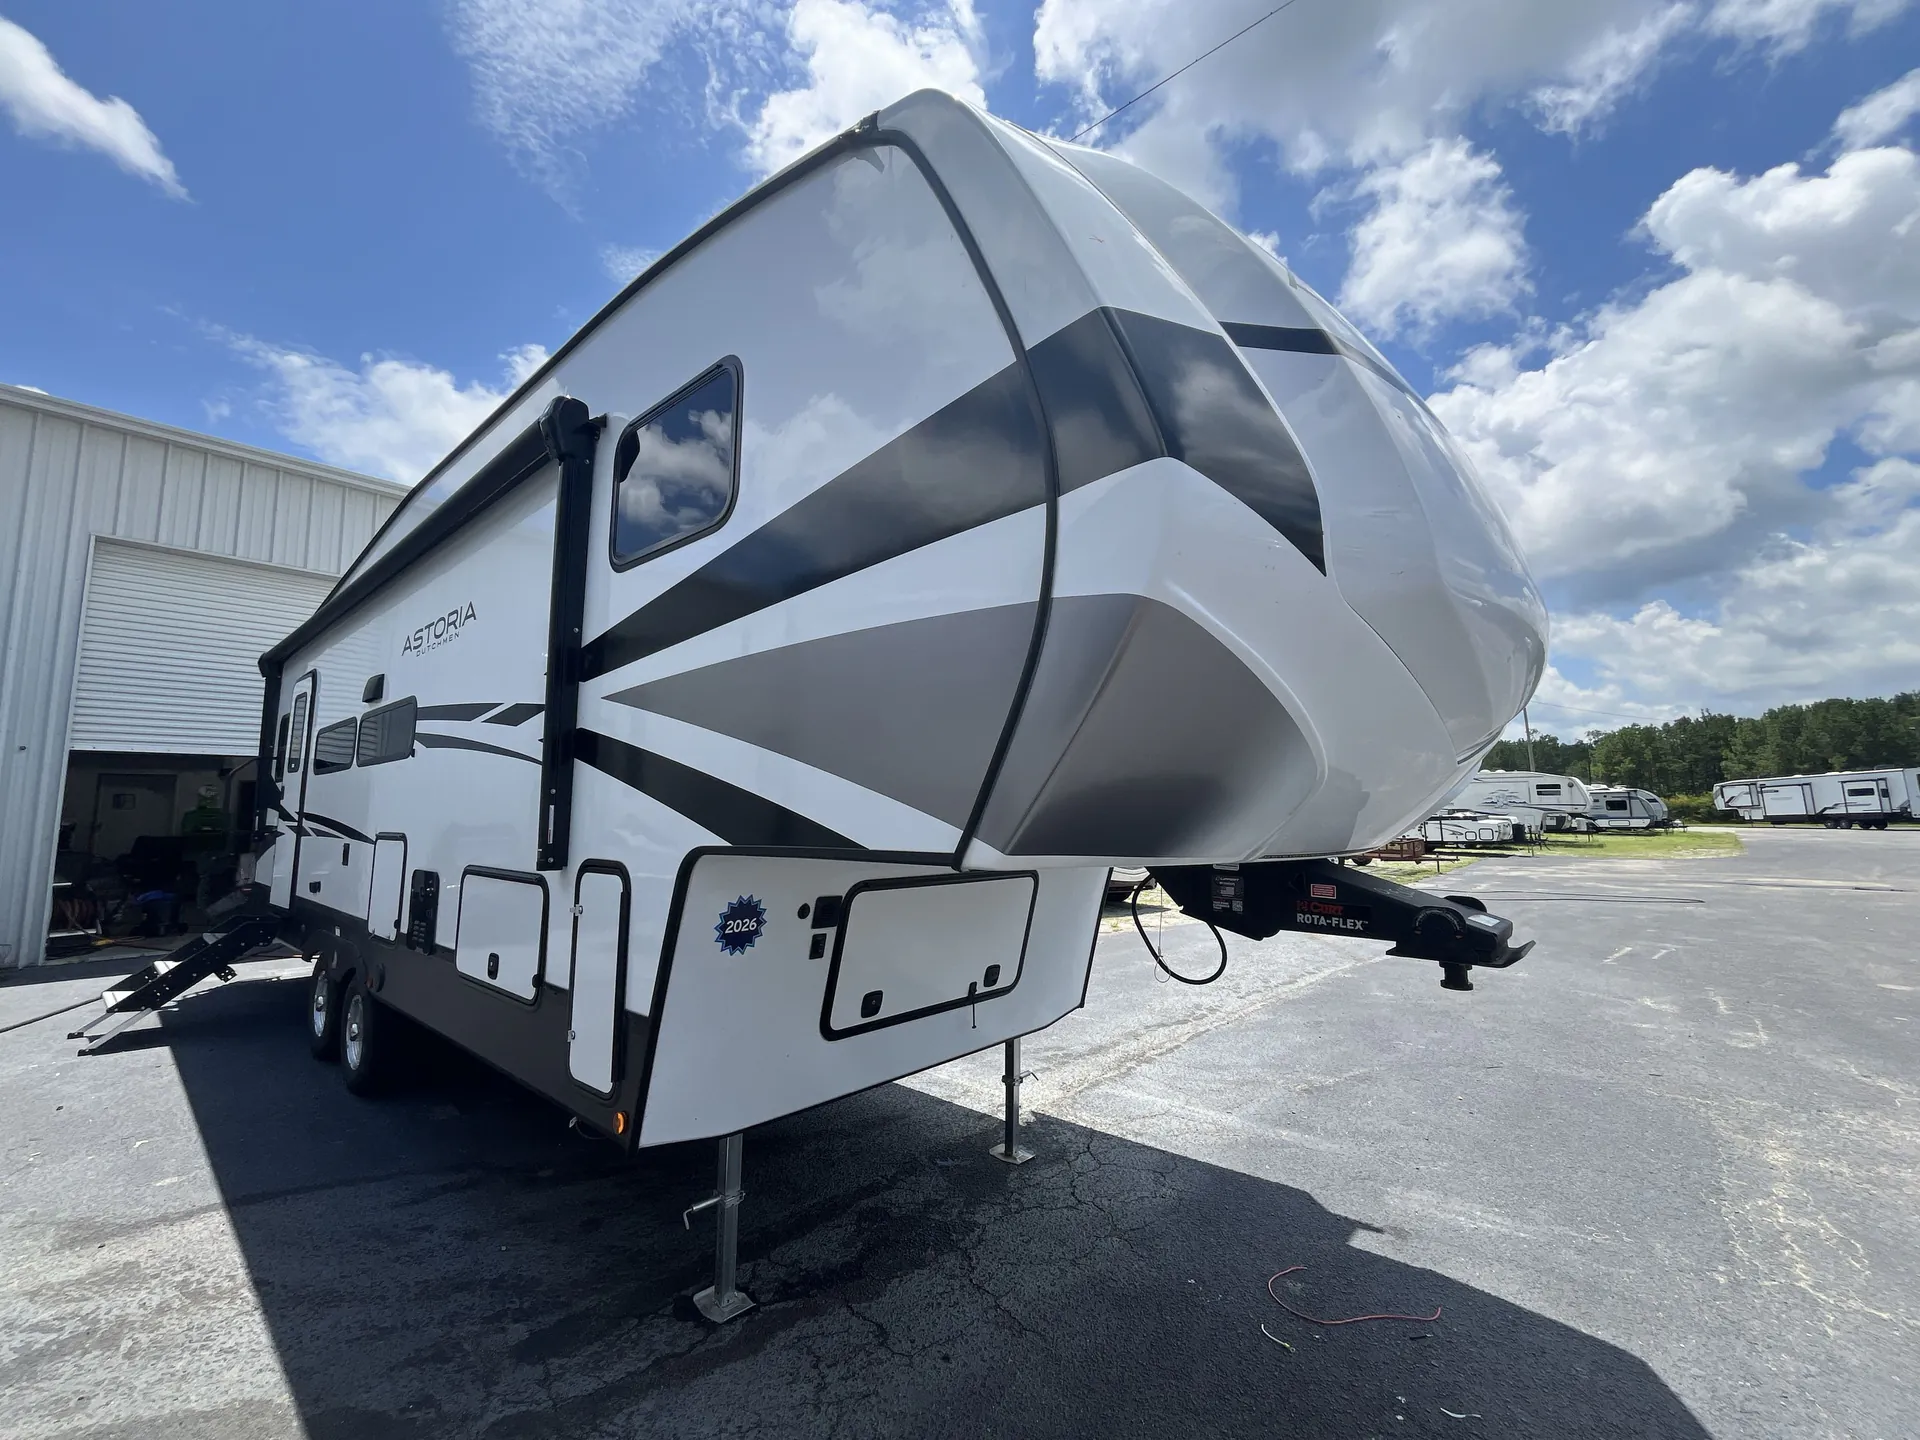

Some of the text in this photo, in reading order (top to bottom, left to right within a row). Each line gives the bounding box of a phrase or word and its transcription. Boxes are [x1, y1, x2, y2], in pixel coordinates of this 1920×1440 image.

[401, 601, 477, 656] ASTORIA
[416, 631, 460, 657] DUTCHMEN
[725, 917, 757, 934] 2026
